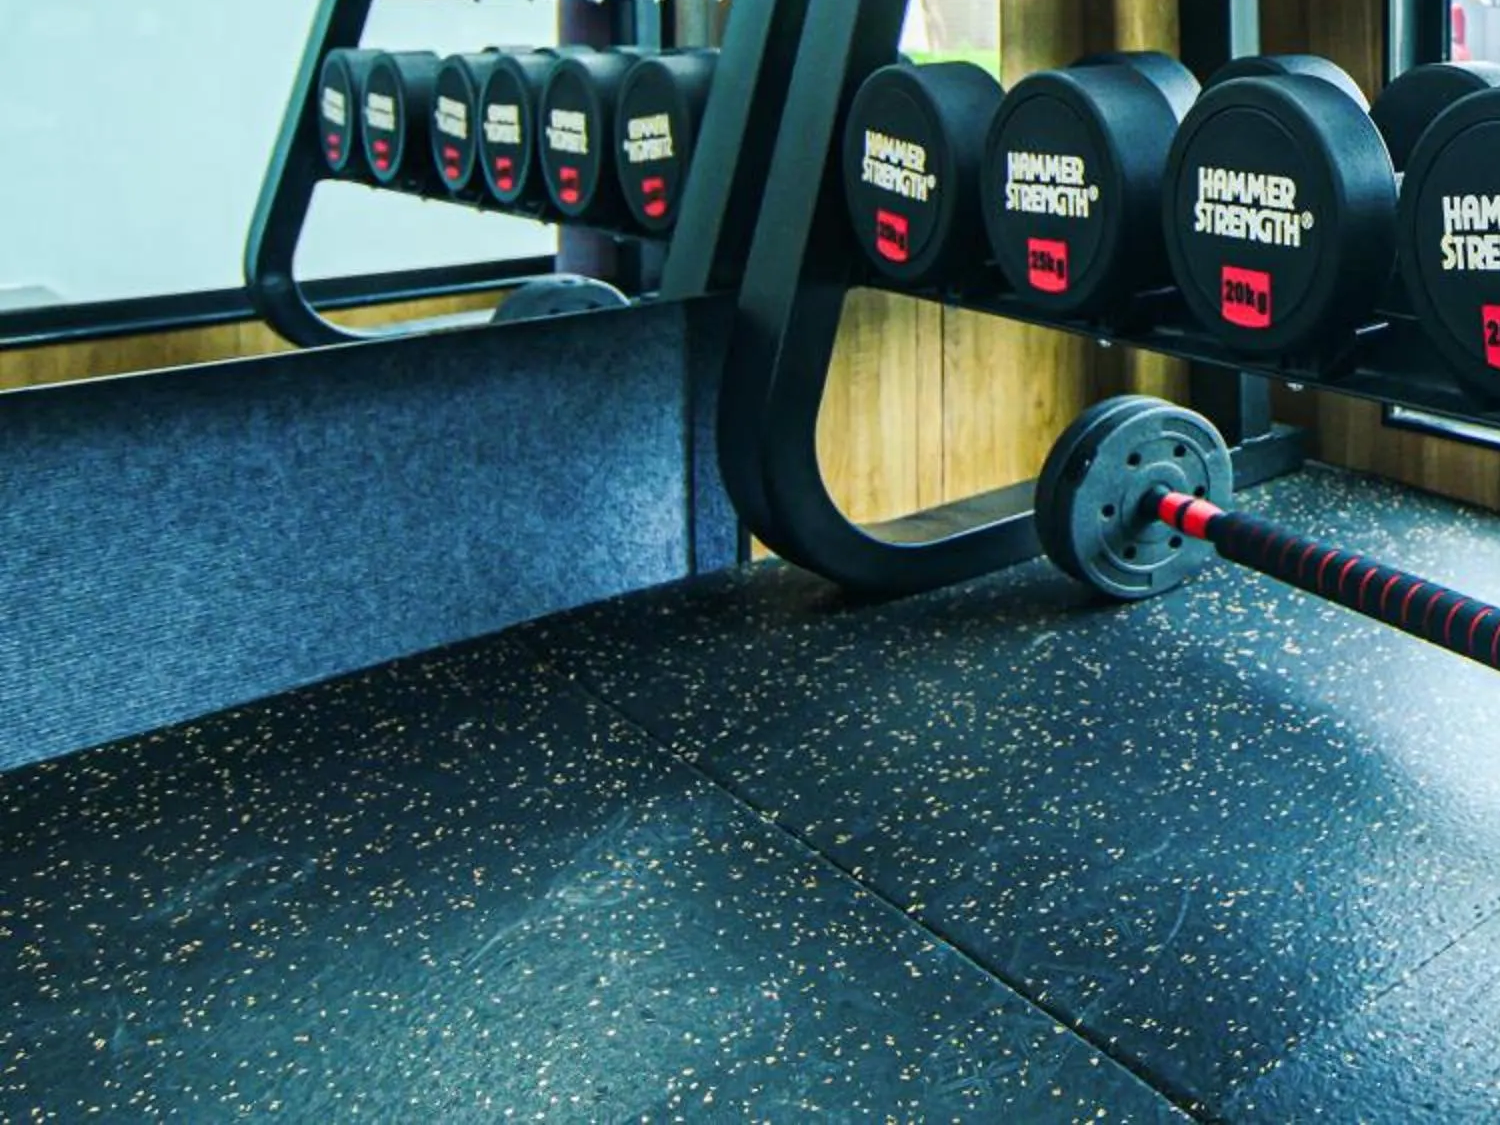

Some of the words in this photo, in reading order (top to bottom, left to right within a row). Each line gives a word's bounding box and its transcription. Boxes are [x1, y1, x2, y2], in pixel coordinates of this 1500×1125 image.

[865, 129, 926, 173] HAMMER
[1007, 150, 1085, 186] HAMMER
[1198, 166, 1297, 211] HAMMER
